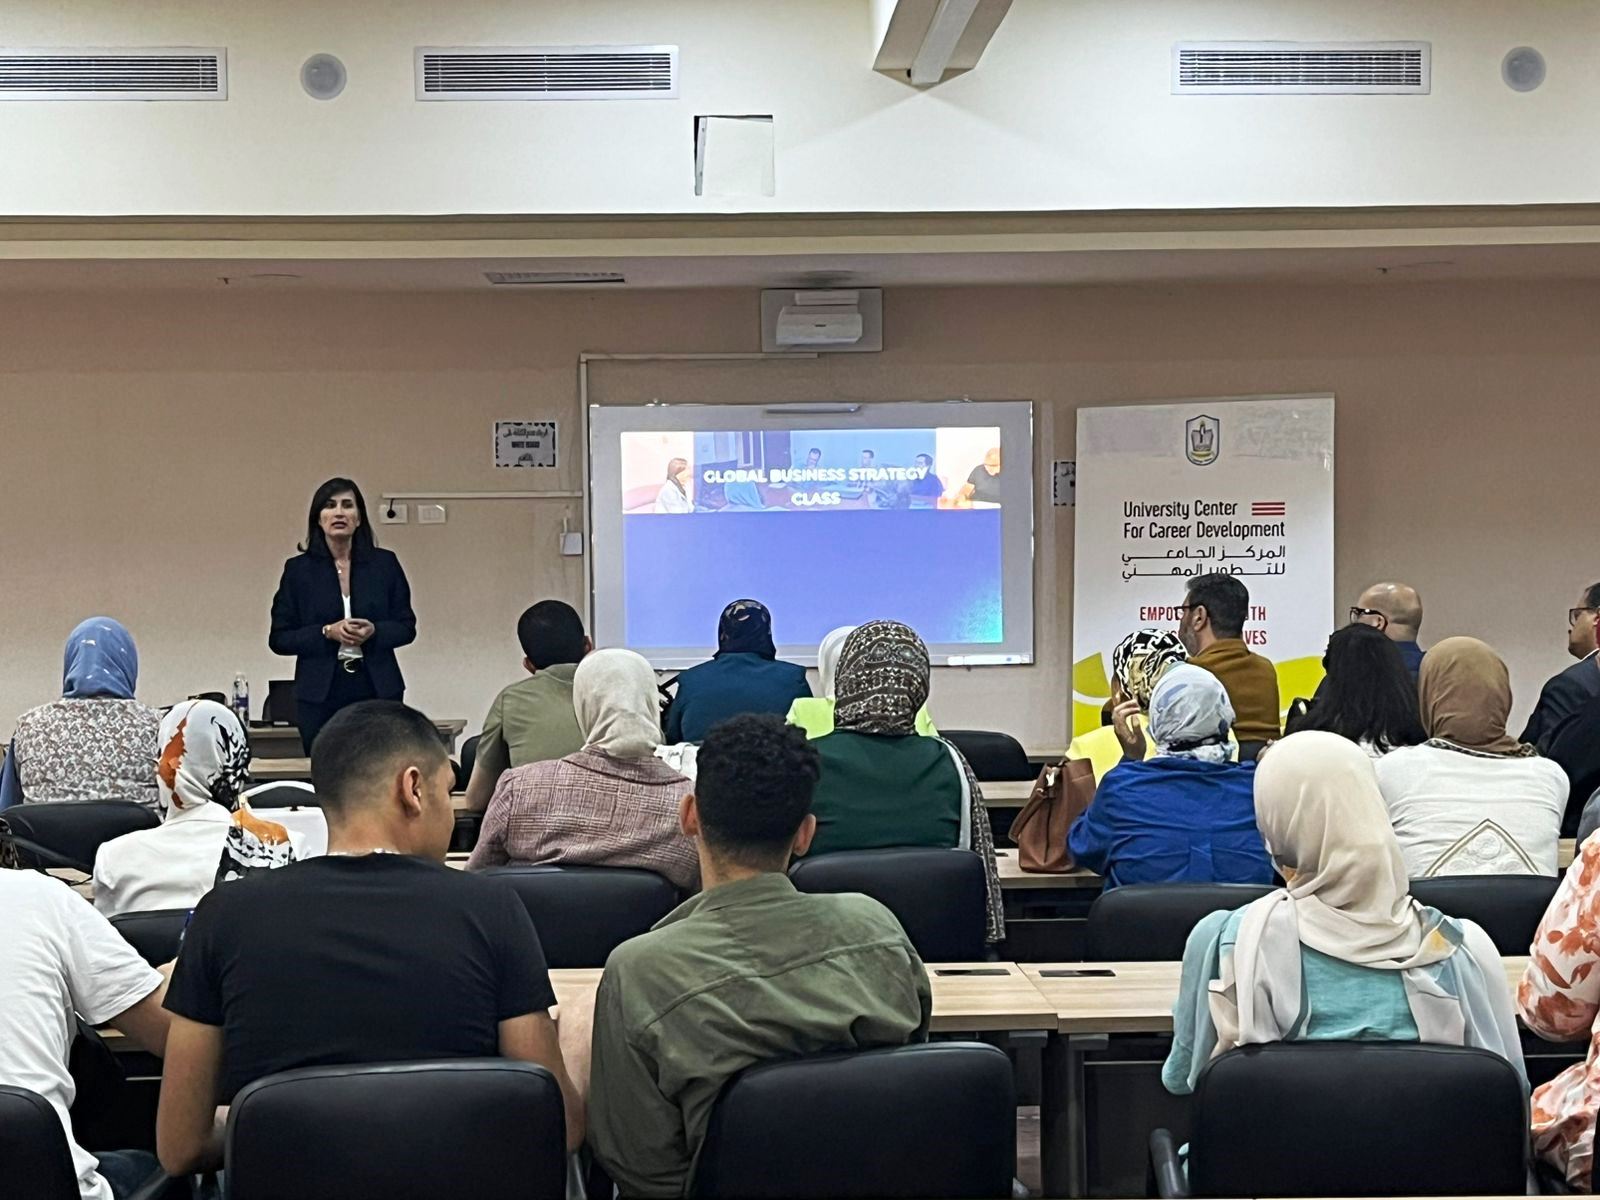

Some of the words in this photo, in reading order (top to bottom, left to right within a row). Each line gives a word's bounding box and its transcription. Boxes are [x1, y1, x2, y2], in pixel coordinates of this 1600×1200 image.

[703, 469, 767, 483] GLOBAL
[770, 468, 846, 482] BUSINESS
[848, 467, 929, 481] STRATEGY
[790, 491, 842, 506] CLASS
[1124, 501, 1190, 520] University
[1194, 500, 1238, 516] Center
[1124, 522, 1145, 539] For
[1149, 522, 1192, 538] Career
[1196, 520, 1285, 541] Development
[1122, 546, 1215, 566] الجامعي
[1217, 545, 1285, 561] المركز
[1122, 563, 1202, 582] المهني
